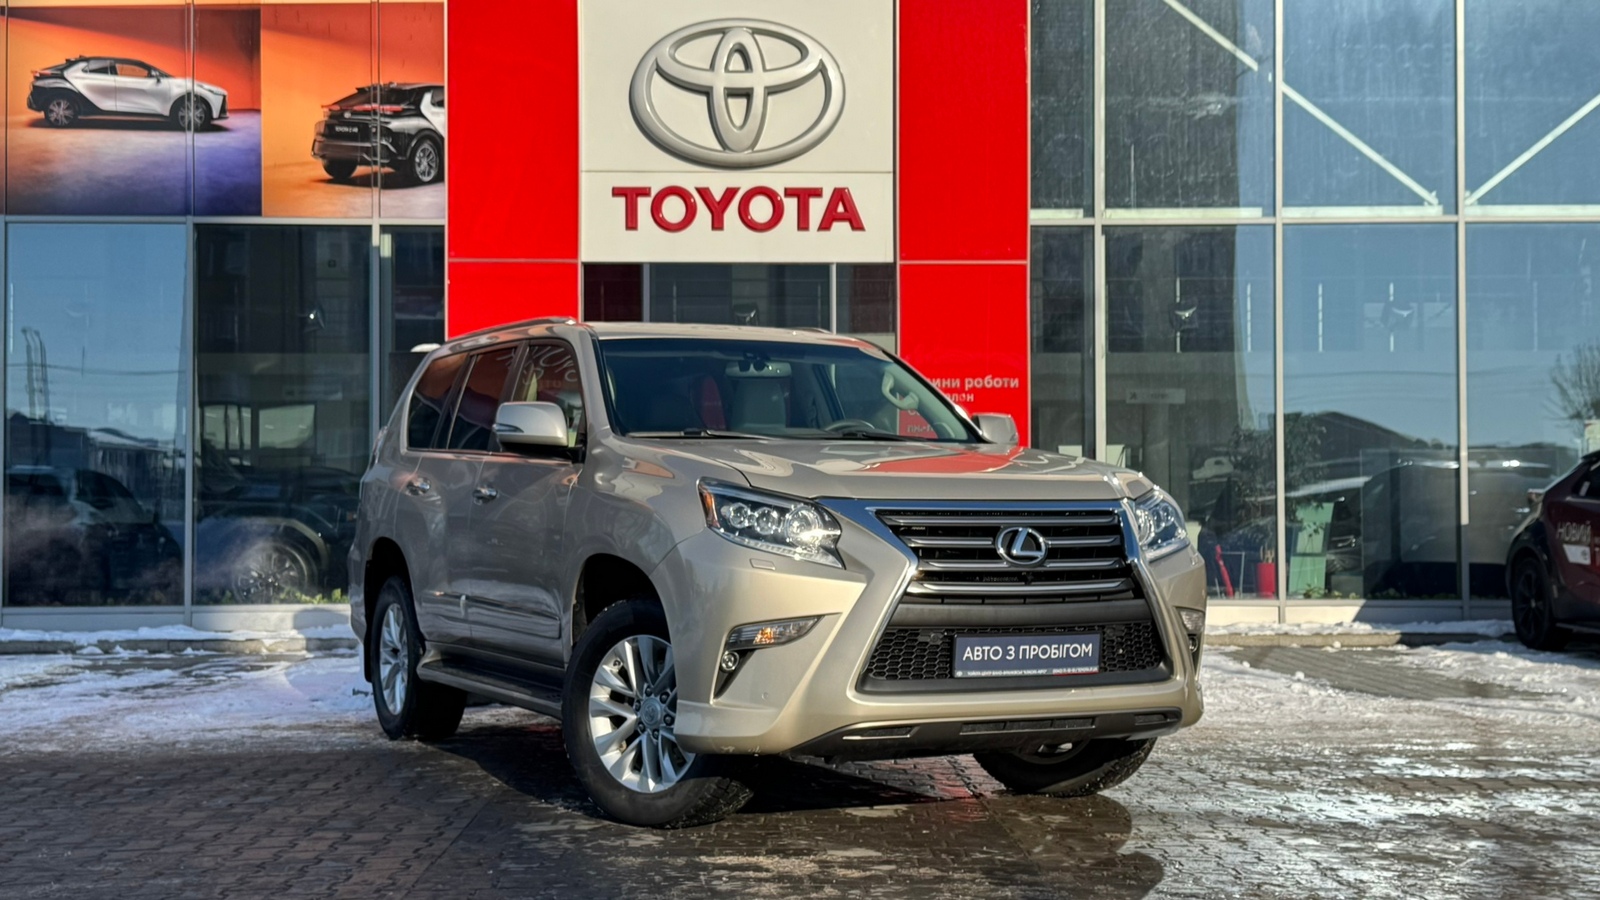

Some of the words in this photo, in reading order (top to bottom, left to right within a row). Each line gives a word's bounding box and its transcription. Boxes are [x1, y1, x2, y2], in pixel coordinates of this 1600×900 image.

[611, 185, 866, 233] TOYOTA
[927, 377, 961, 389] ини
[965, 375, 1020, 391] роботи
[1555, 520, 1592, 543] НОВИЙ
[962, 645, 1003, 661] АВТО
[1019, 643, 1093, 660] ПРОБІГОМ
